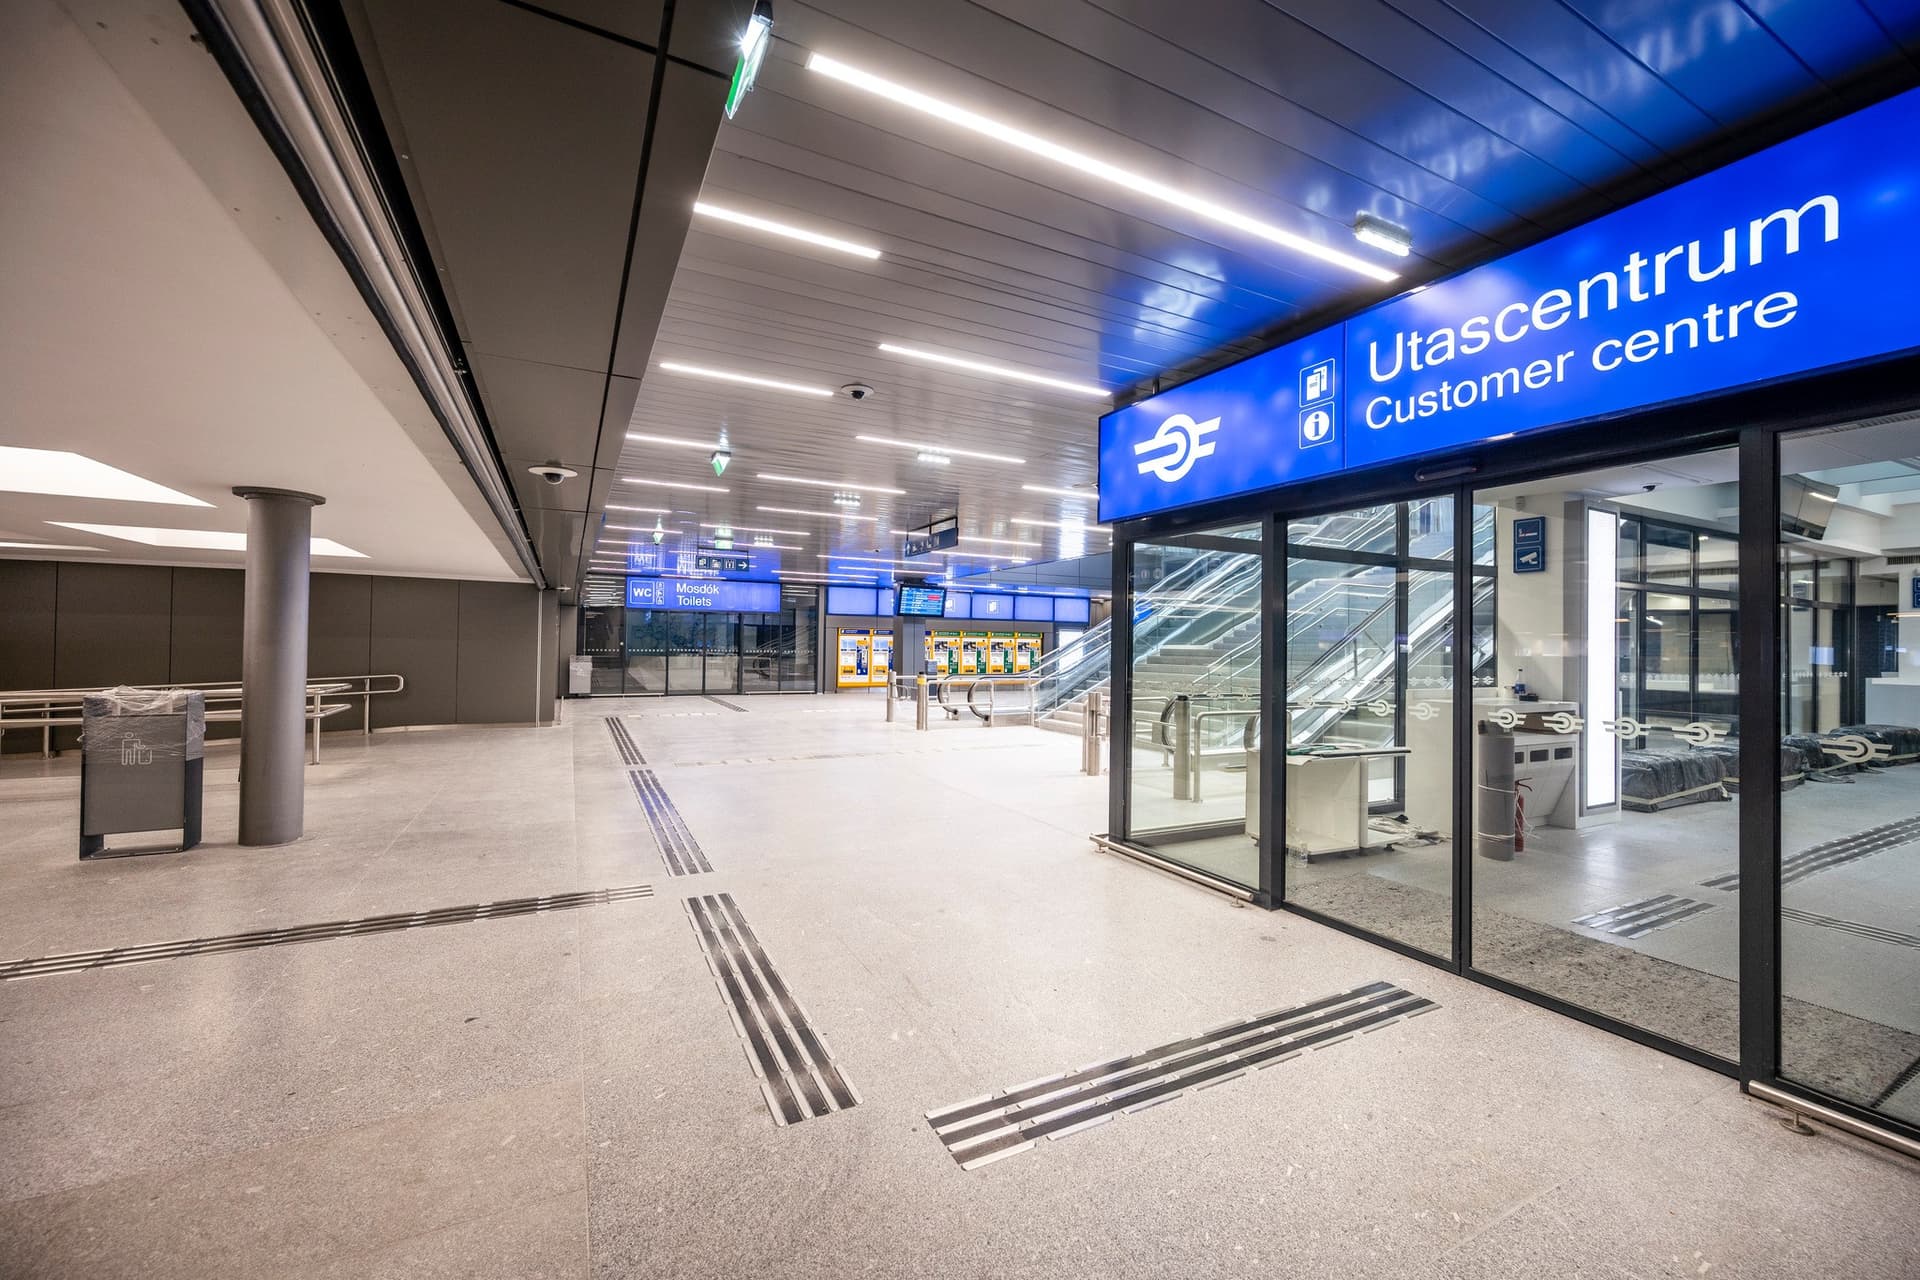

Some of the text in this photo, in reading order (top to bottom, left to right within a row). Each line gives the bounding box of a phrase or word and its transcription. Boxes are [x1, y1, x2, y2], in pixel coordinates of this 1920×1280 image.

[1368, 194, 1840, 383] Utascentrum
[1365, 290, 1799, 430] Customer centre
[633, 588, 652, 597] WC
[676, 583, 720, 595] Mosdók
[676, 595, 712, 607] Toilets
